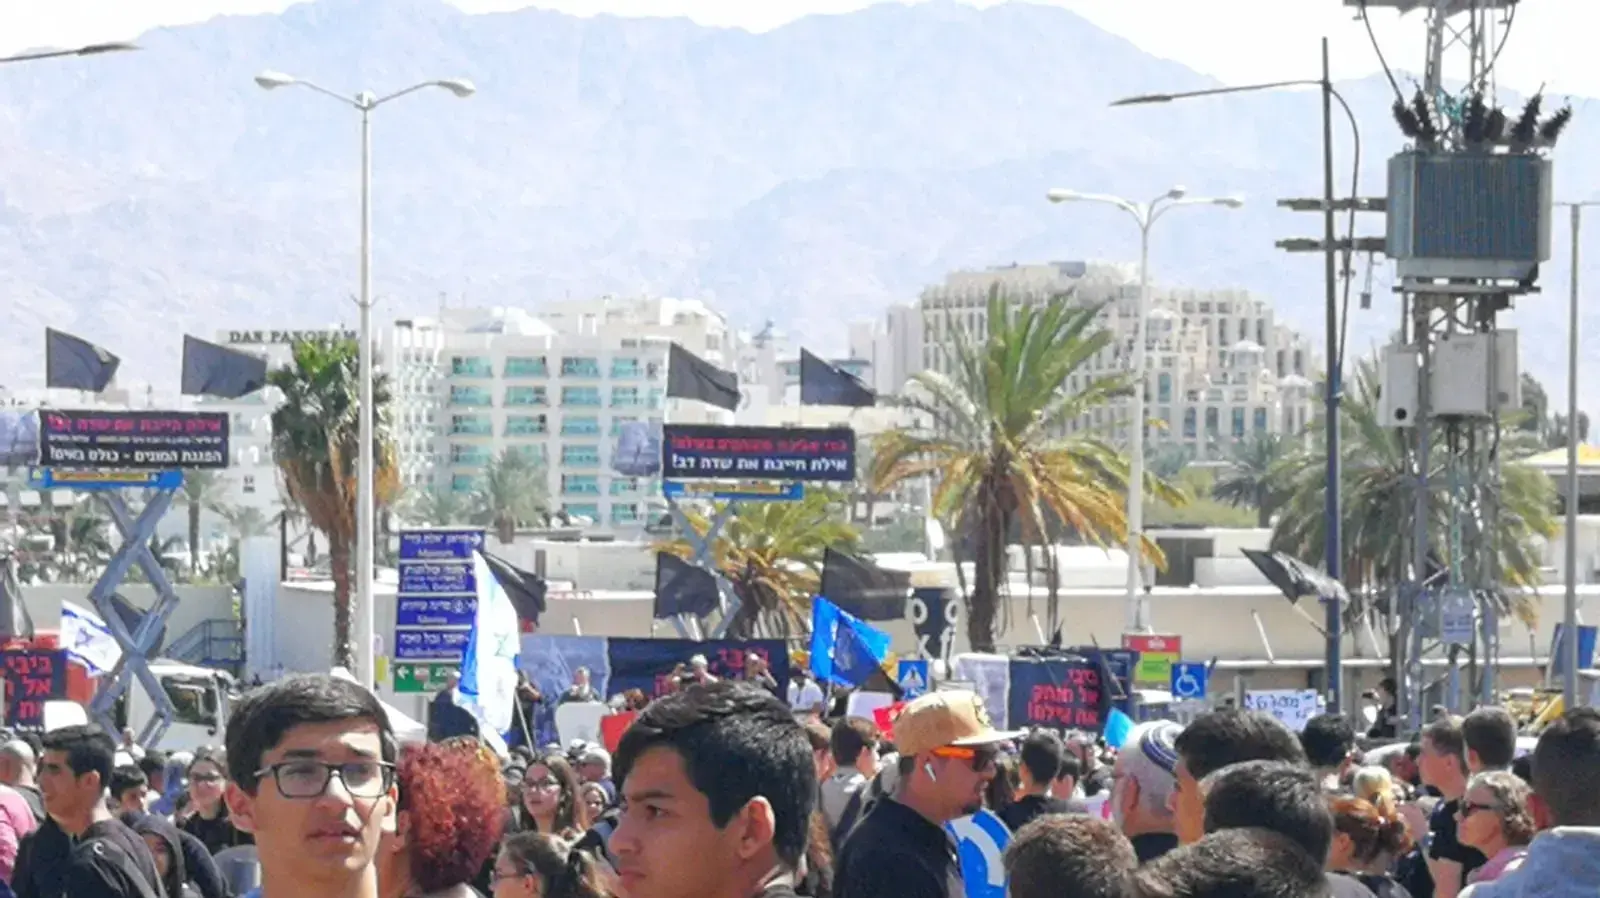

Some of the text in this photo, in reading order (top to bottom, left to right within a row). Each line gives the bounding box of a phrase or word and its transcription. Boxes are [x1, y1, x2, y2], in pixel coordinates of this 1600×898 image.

[229, 330, 263, 342] DAN
[50, 446, 85, 461] באים!
[89, 448, 119, 462] כולם
[134, 450, 177, 463] המונים
[181, 450, 223, 463] הפגנת
[671, 454, 848, 471] אילת חייבת את שדה דב!
[22, 675, 51, 697] אל
